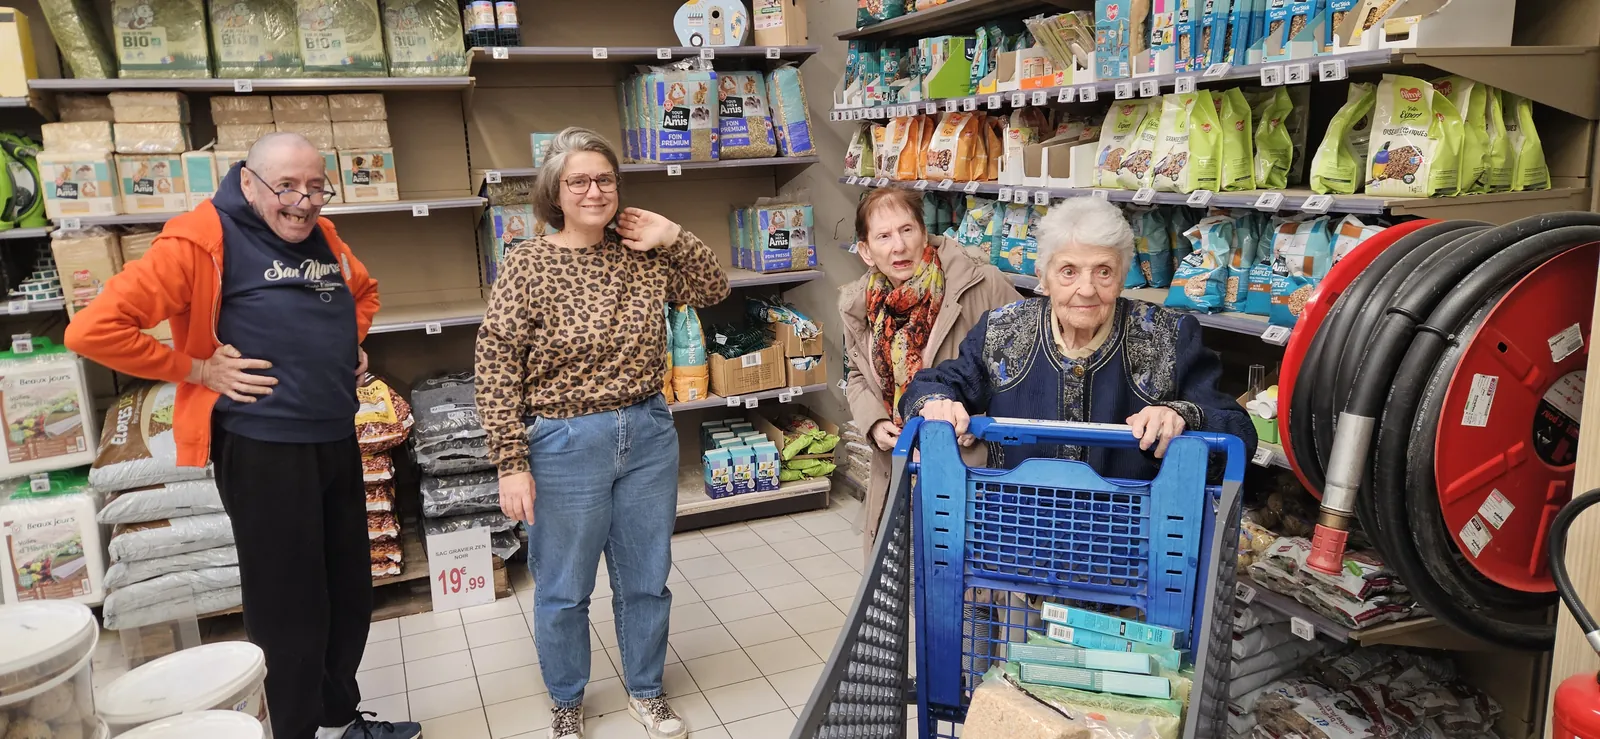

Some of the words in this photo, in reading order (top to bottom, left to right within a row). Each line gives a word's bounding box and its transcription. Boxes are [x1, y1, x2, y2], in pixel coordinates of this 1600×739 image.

[123, 35, 149, 48] BIO
[306, 37, 330, 49] BIO
[1400, 90, 1422, 100] Aimé
[720, 104, 742, 115] Amis
[664, 115, 688, 127] Amis
[661, 139, 689, 147] PREMIUM
[769, 237, 789, 247] Amis
[264, 260, 299, 281] San
[20, 377, 46, 386] Beaux
[48, 374, 71, 384] jours
[27, 521, 52, 530] Beaux
[54, 516, 75, 526] jours
[448, 546, 474, 555] GRAVIER
